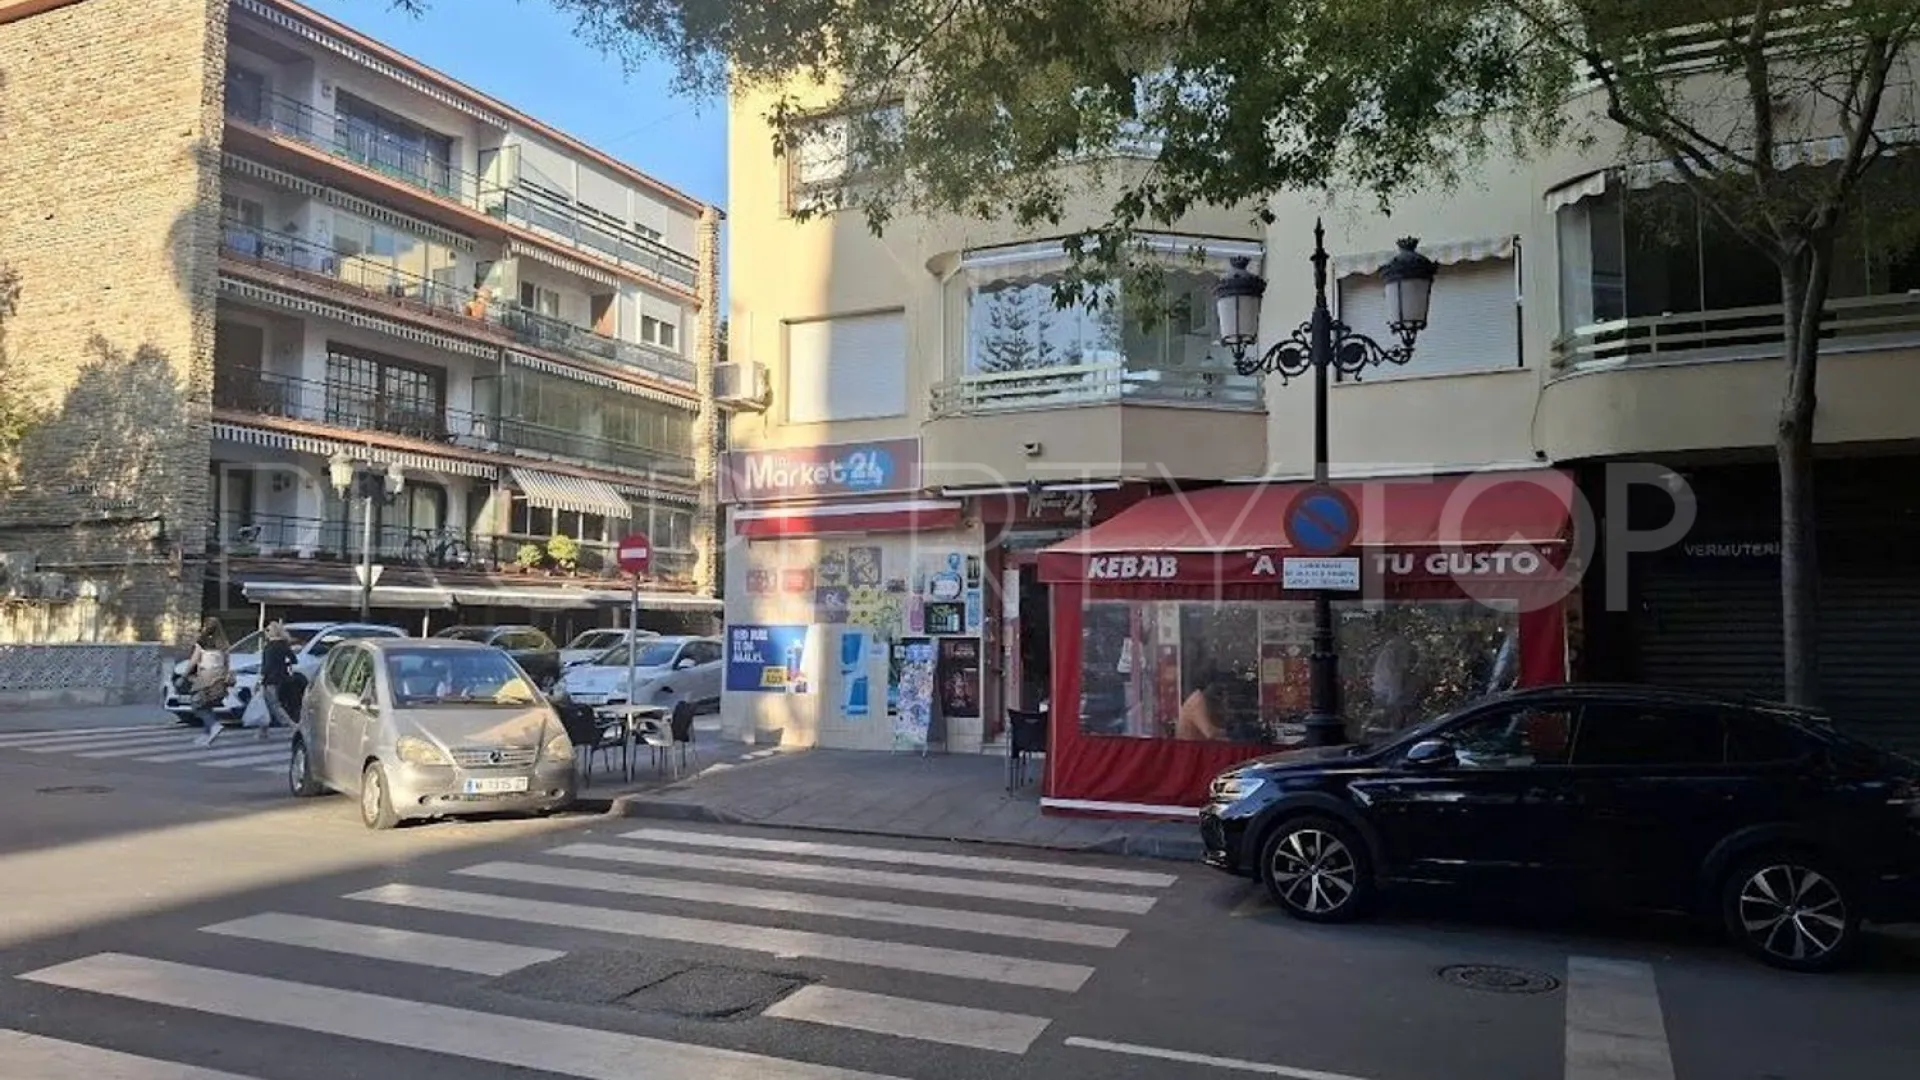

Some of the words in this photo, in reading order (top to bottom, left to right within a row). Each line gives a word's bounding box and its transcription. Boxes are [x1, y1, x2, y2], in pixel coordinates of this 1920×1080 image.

[744, 454, 847, 490] Market
[850, 450, 883, 486] 24
[1684, 541, 1782, 556] VERMUTERI
[1088, 555, 1178, 578] KEBAB
[1372, 553, 1414, 574] TU
[1425, 549, 1551, 575] GUSTO"
